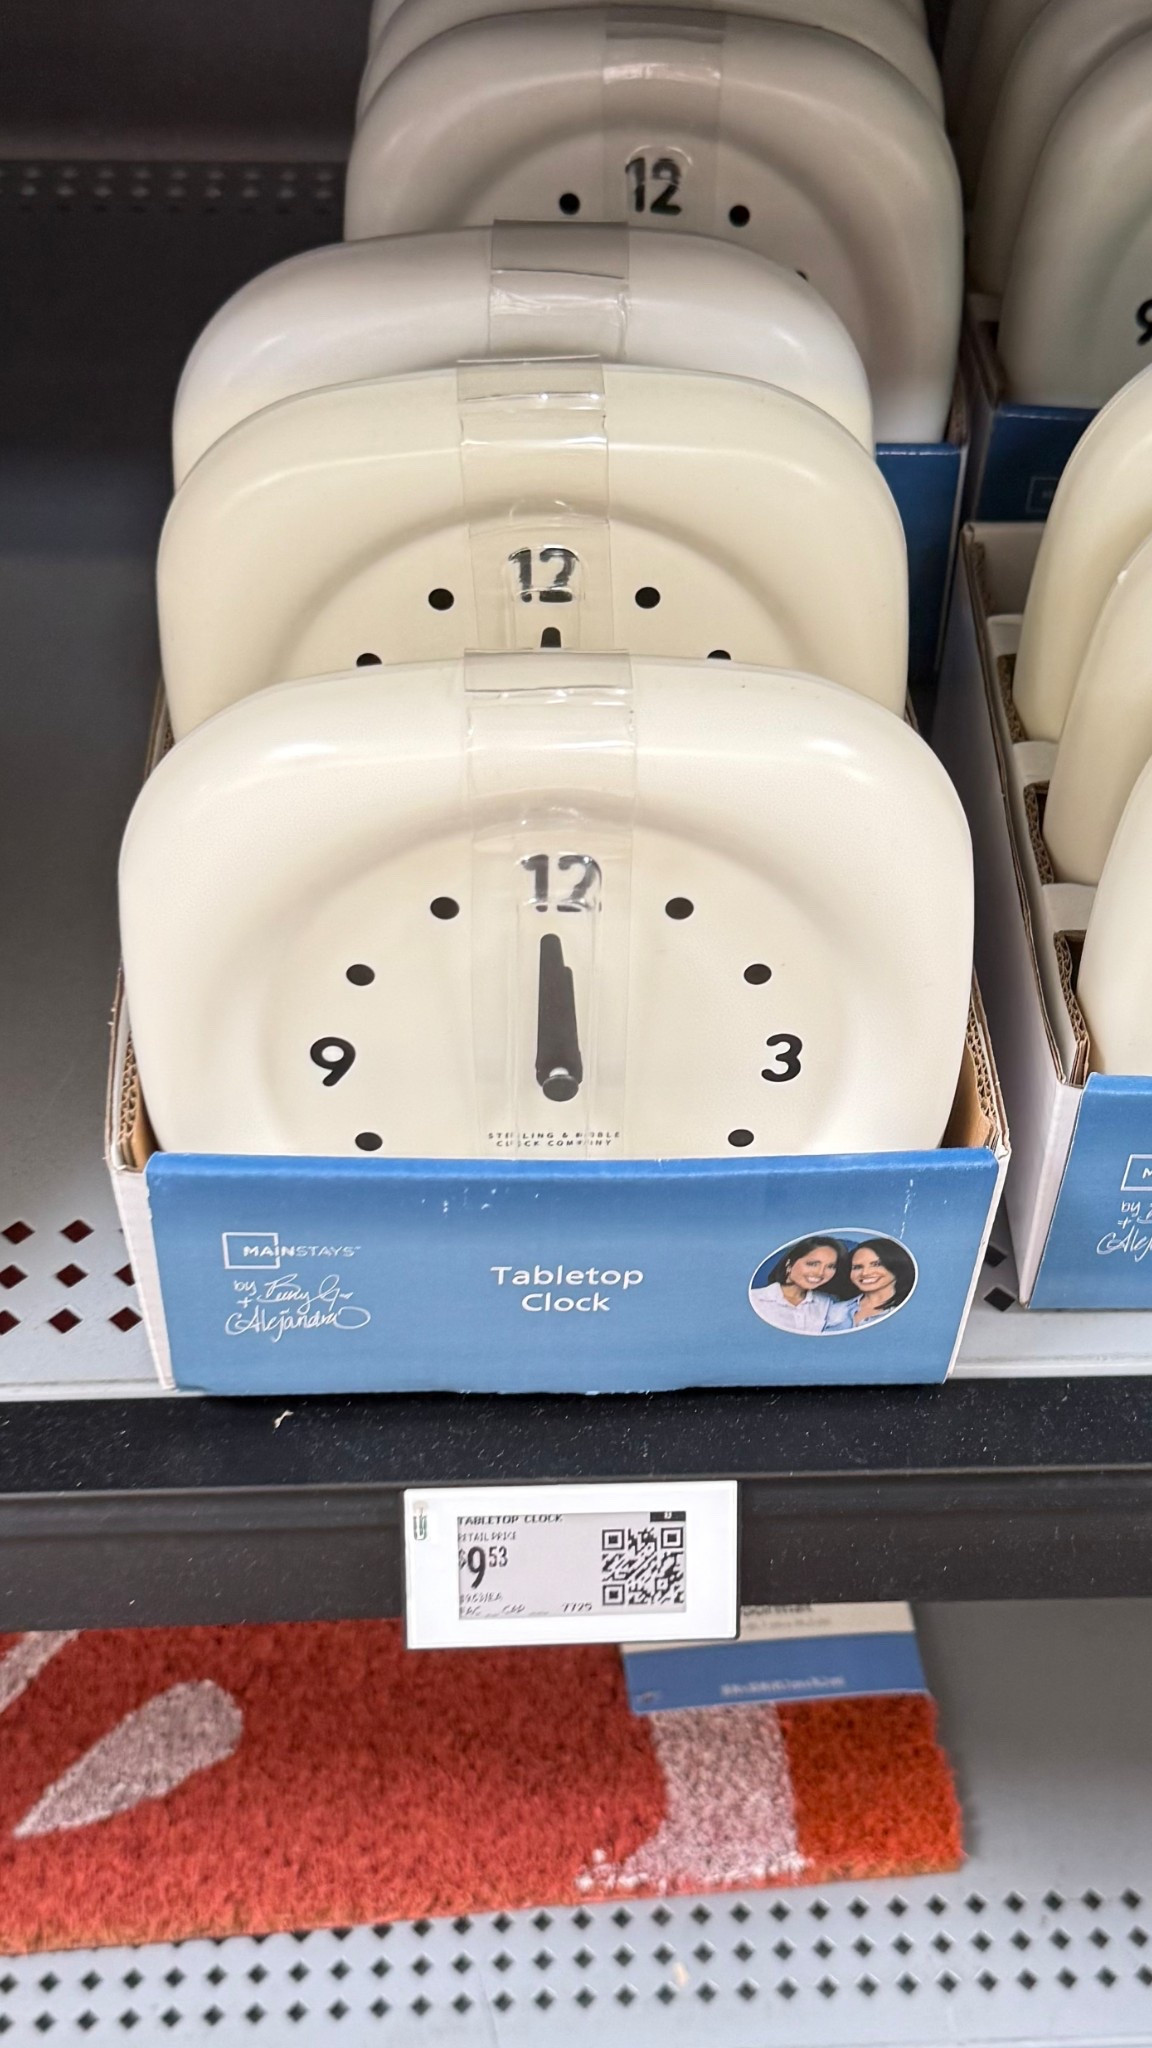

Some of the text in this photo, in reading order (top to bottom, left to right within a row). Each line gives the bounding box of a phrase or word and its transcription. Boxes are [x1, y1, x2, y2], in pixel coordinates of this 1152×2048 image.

[625, 157, 682, 216] 12
[508, 547, 580, 603] 12
[520, 854, 602, 913] 12
[310, 1036, 356, 1087] 9
[761, 1033, 803, 1082] 3
[488, 1132, 554, 1140] STELING
[1121, 1200, 1141, 1218] by
[234, 1280, 257, 1296] by
[490, 1265, 644, 1290] Tabletop
[521, 1292, 611, 1312] Clock
[457, 1513, 563, 1526] TABLETOP CLOCK
